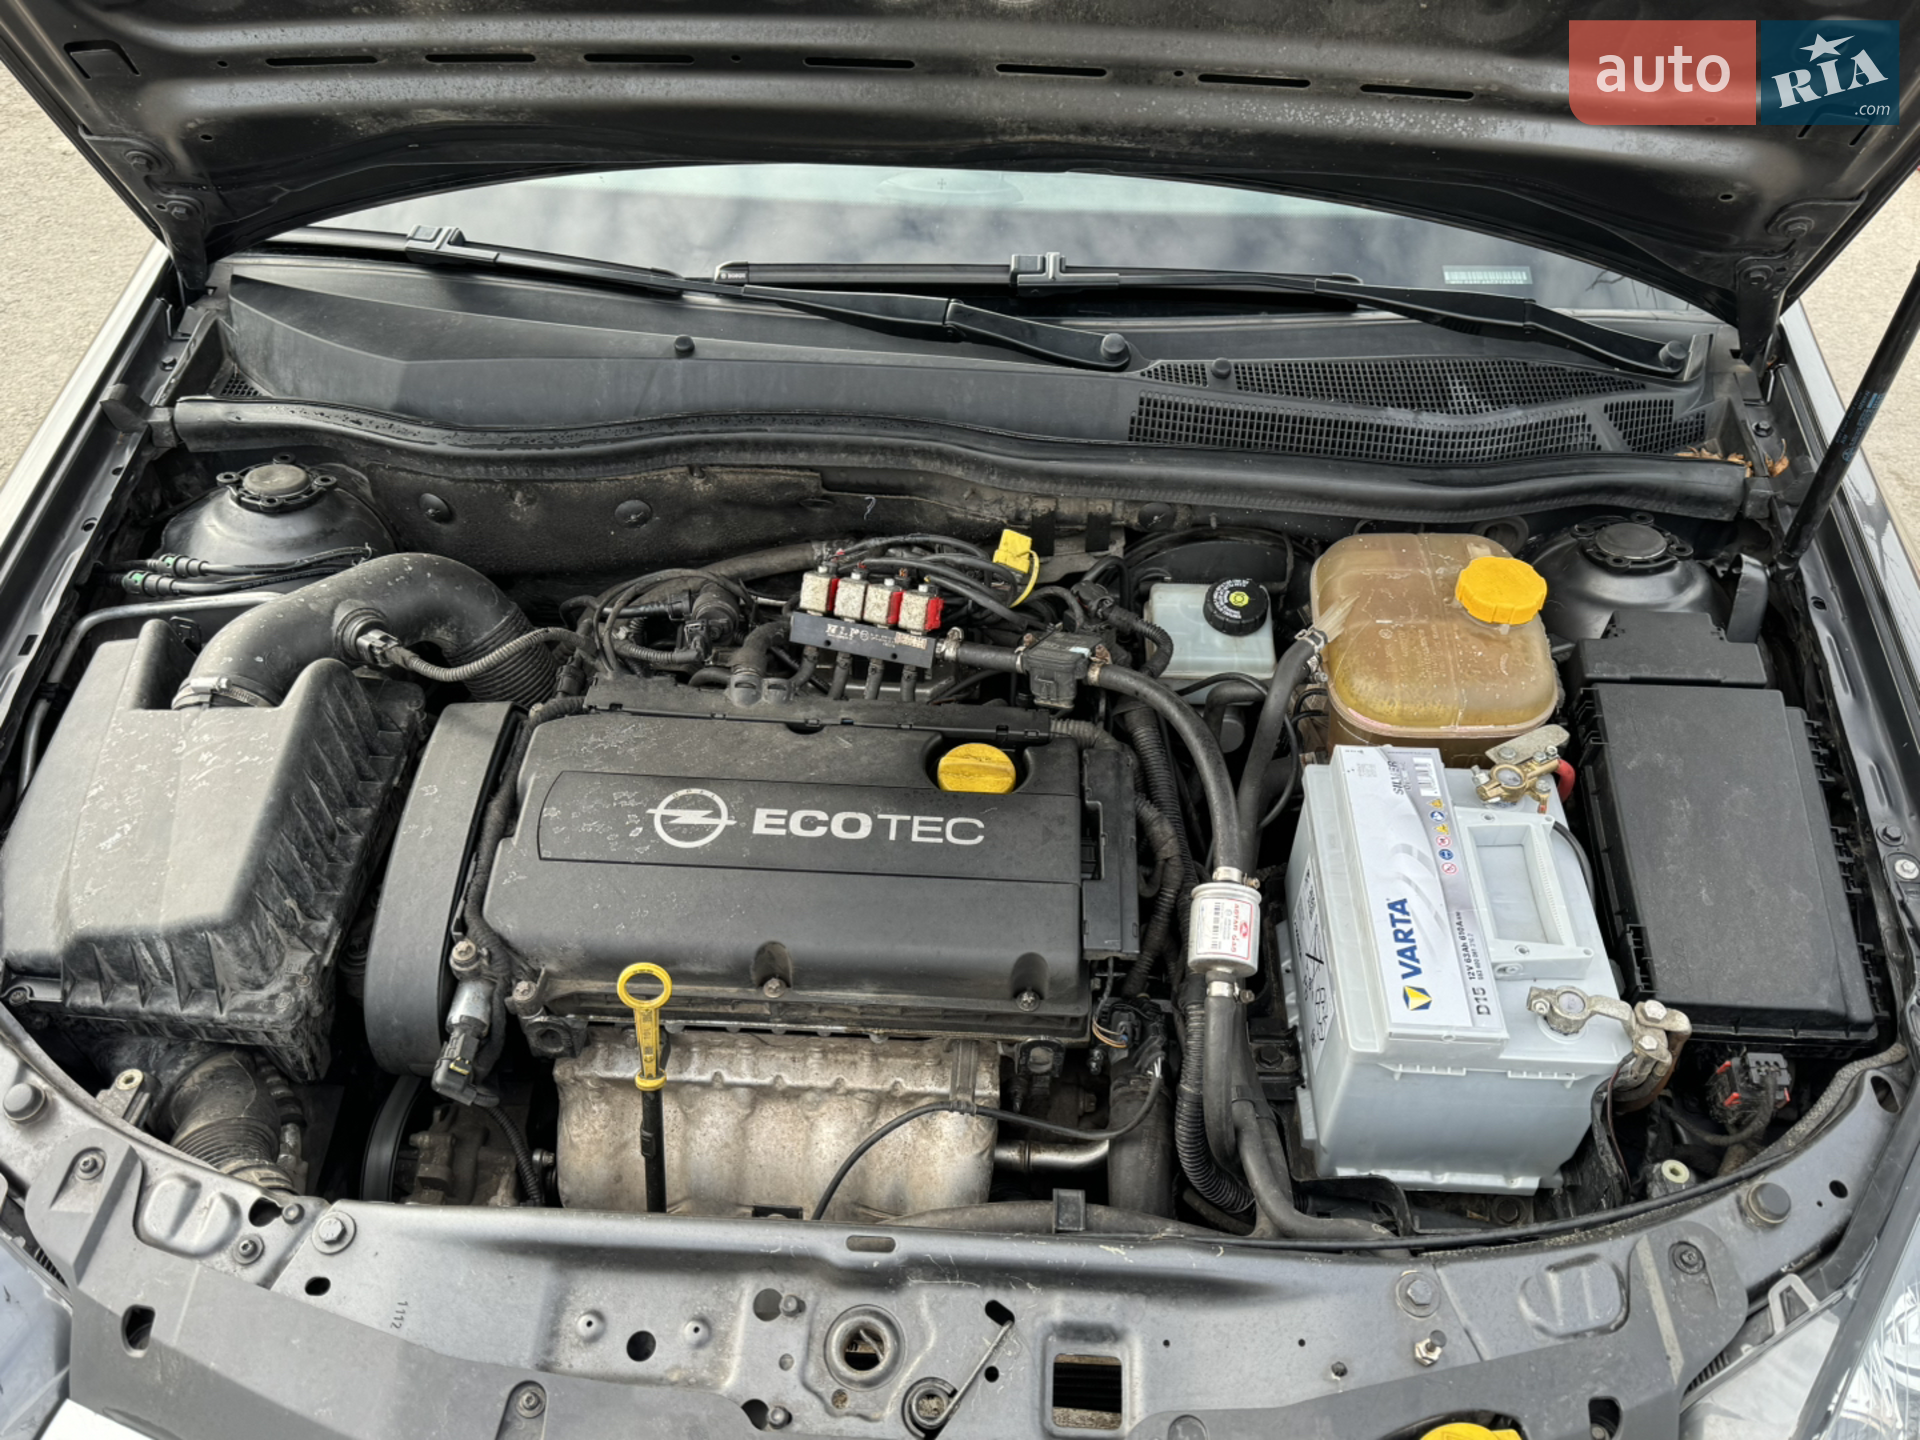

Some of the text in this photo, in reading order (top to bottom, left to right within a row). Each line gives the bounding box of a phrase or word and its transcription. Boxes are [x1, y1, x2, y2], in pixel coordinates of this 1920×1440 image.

[752, 808, 985, 846] ECOTEC
[1387, 898, 1423, 980] VARTA
[1461, 942, 1472, 964] 63Ah
[1465, 965, 1476, 981] 12V
[1472, 987, 1491, 1015] D15
[390, 1301, 408, 1329] 1112
